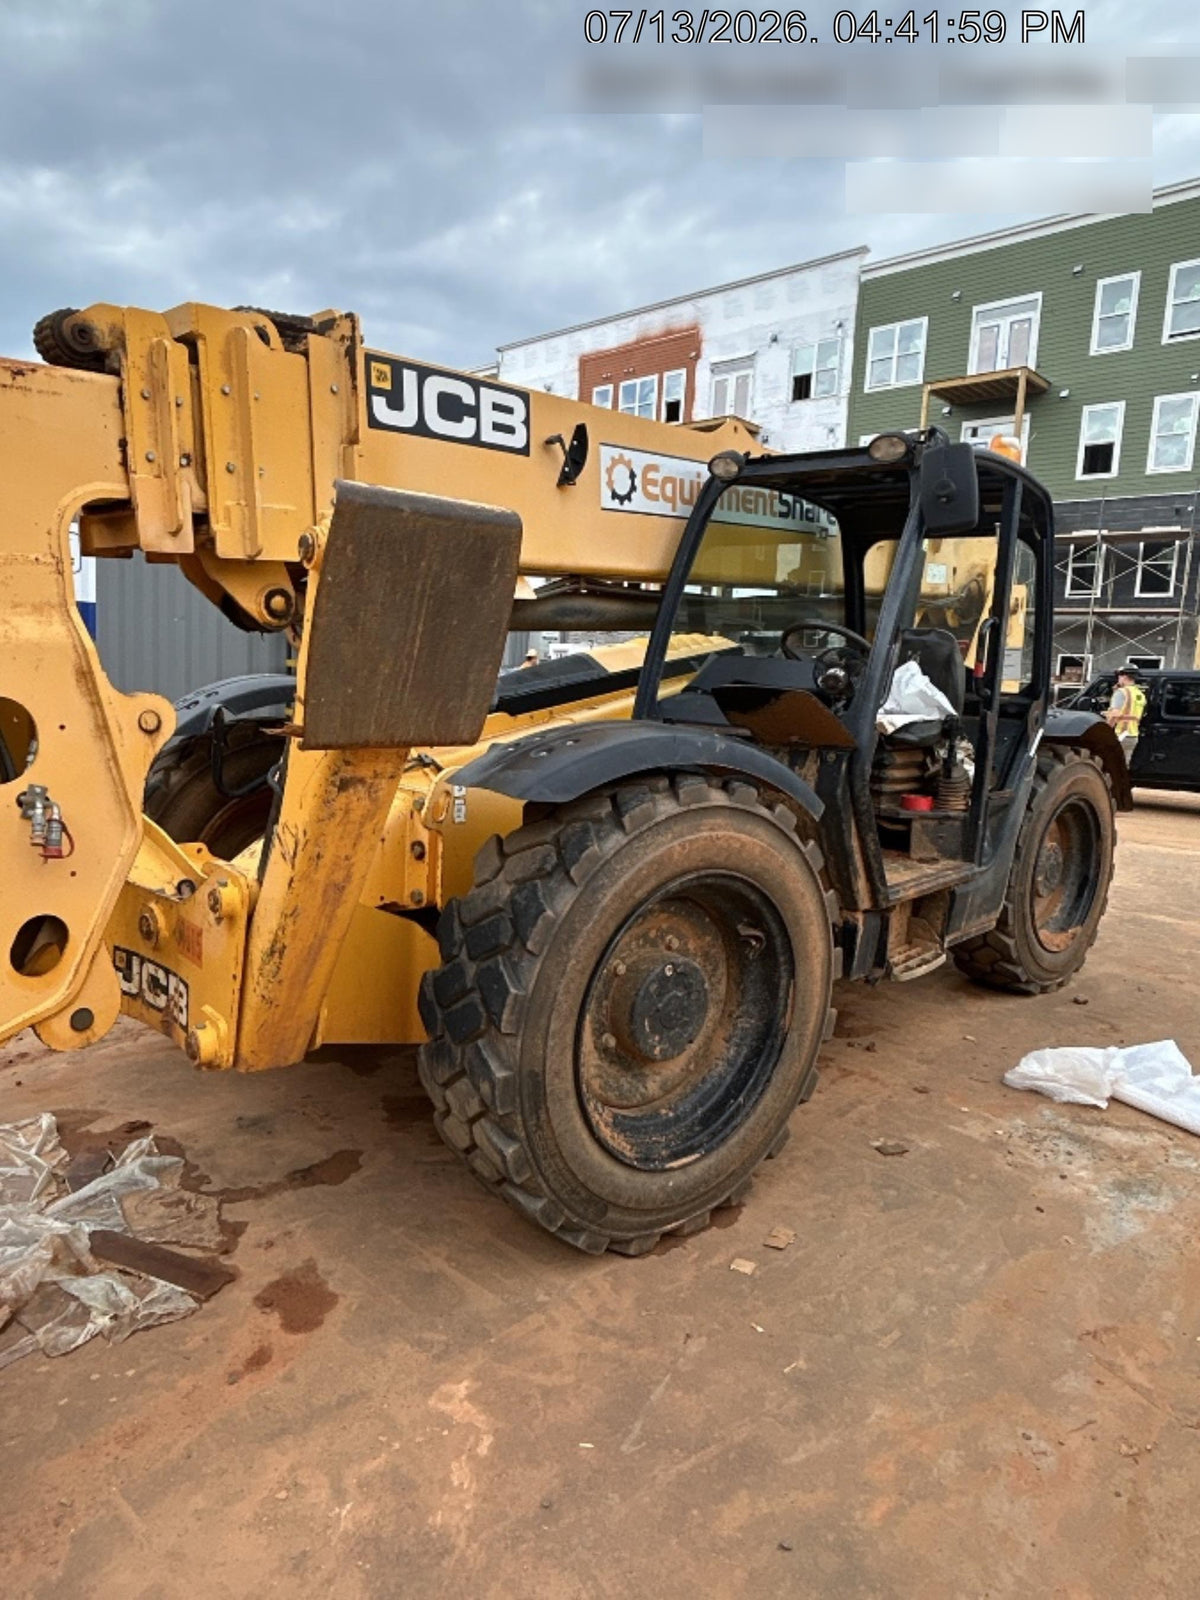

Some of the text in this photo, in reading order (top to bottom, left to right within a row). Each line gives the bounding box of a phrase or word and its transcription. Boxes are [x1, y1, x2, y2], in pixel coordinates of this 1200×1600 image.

[371, 368, 527, 449] JCB
[642, 463, 837, 525] EquimentShare
[117, 955, 188, 1027] JCB
